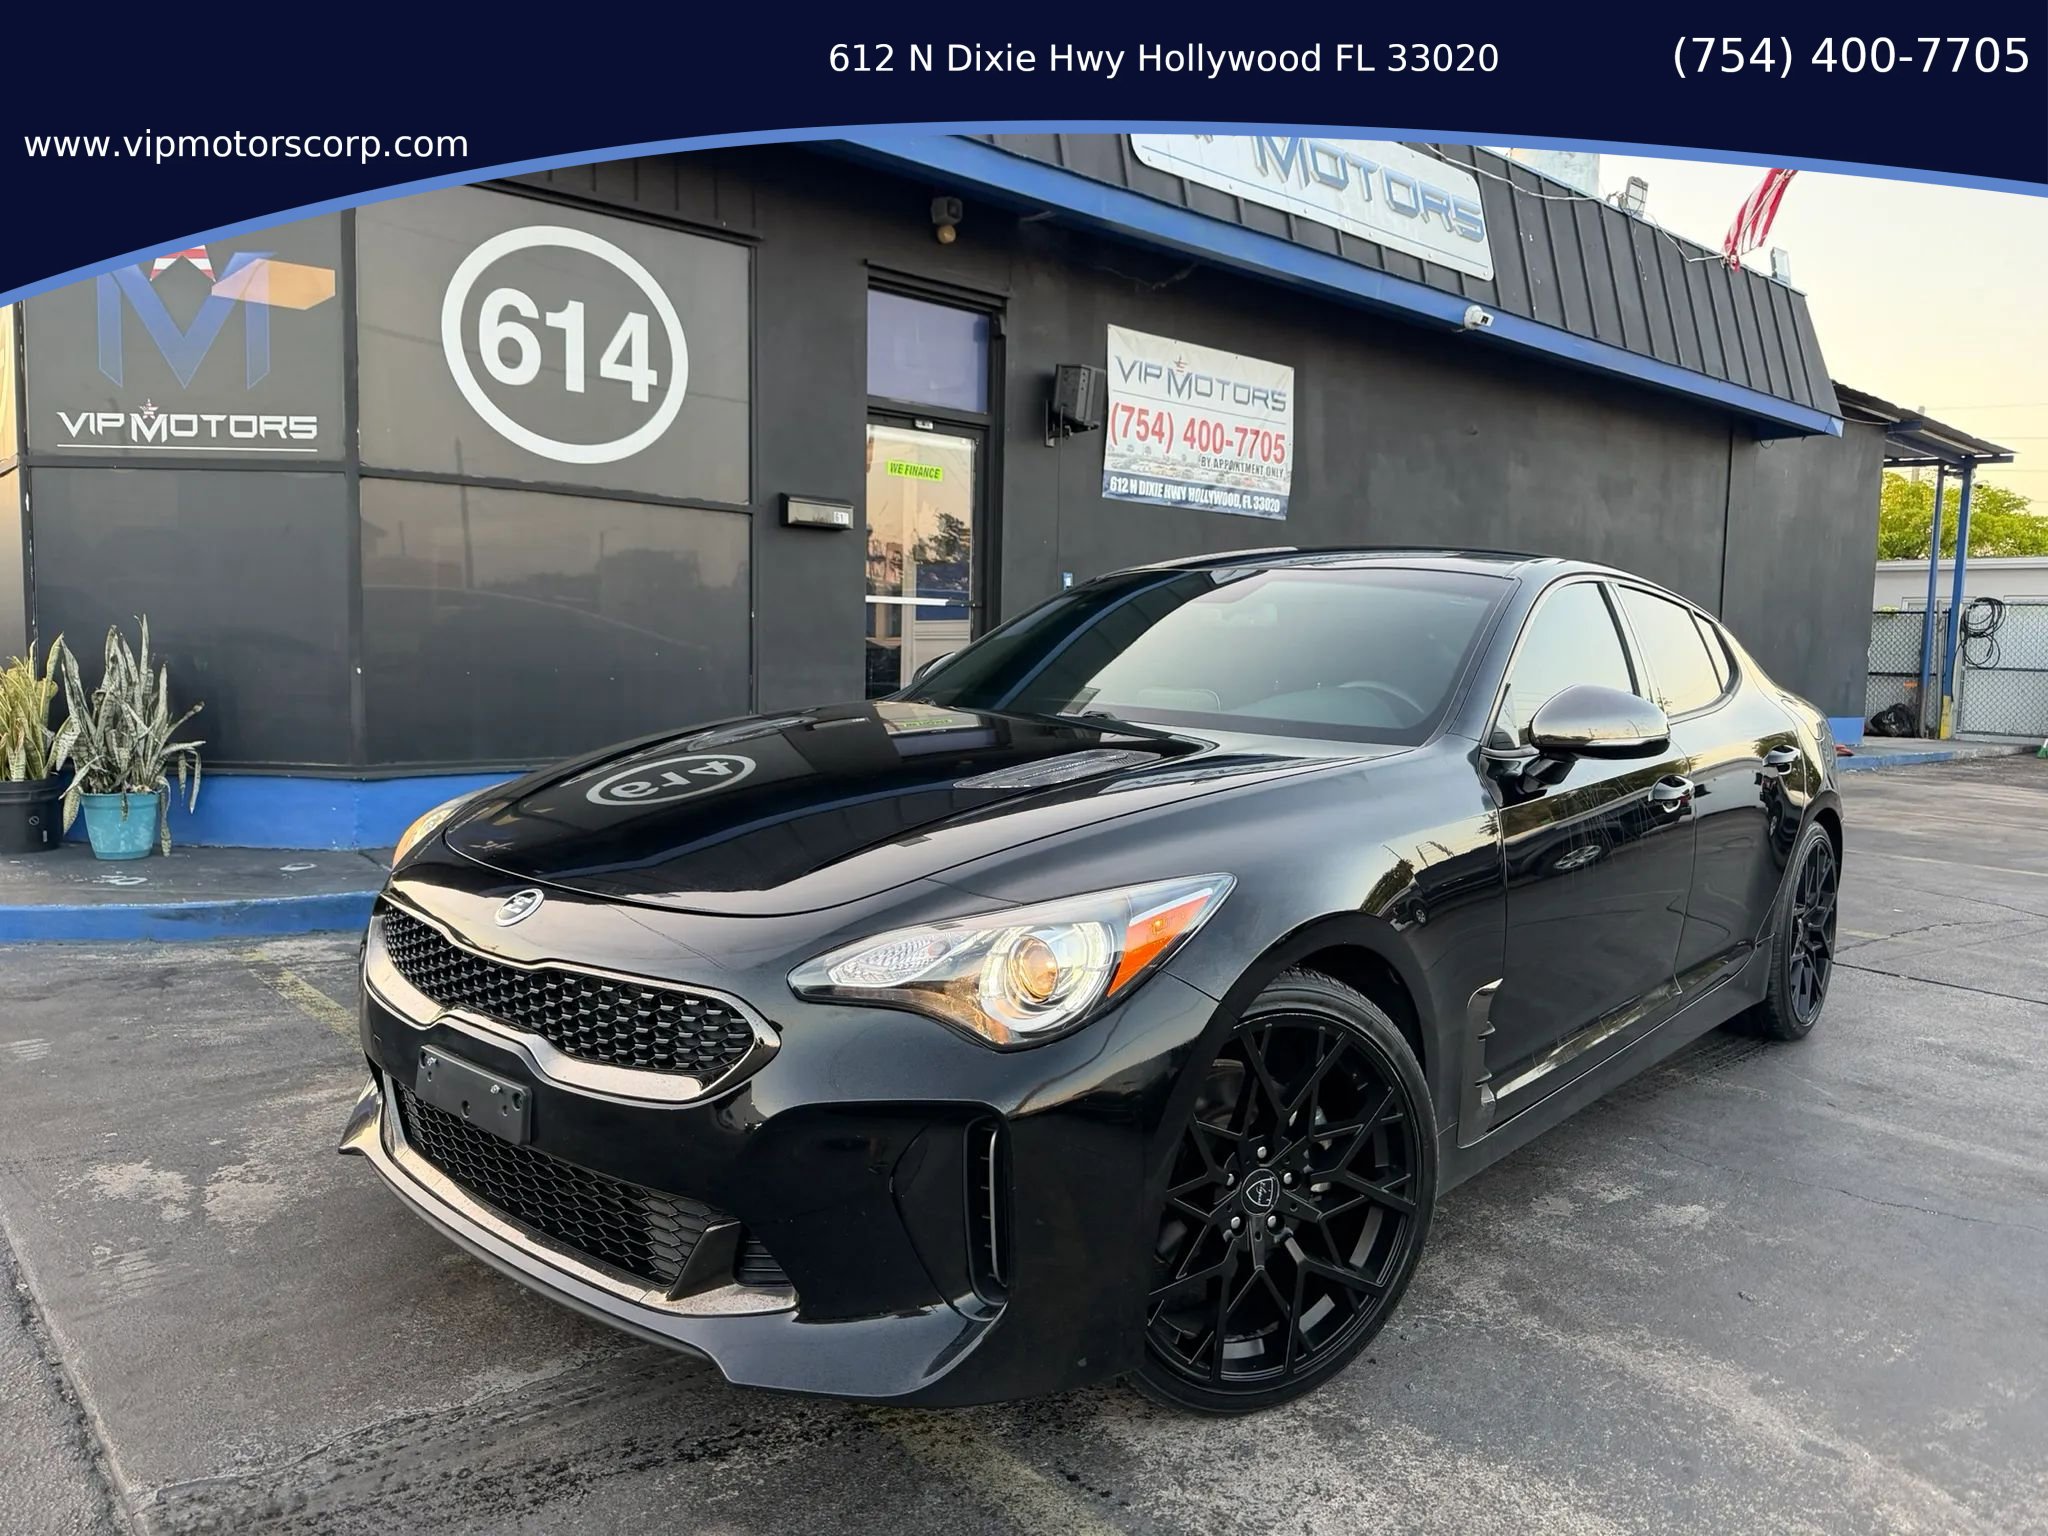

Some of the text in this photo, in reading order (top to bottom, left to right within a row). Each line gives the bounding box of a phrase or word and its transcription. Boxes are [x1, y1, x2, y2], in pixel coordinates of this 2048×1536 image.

[478, 286, 658, 403] 614
[1115, 355, 1287, 413] VIP MOTORS
[56, 411, 318, 443] VIP MOTORS
[1110, 402, 1286, 465] (754) 400-7705
[890, 462, 941, 479] WE FINANCE
[1201, 456, 1284, 479] BY APPOINTMENT ONLY
[1109, 476, 1129, 493] 612
[1129, 478, 1138, 495] N
[1138, 480, 1164, 498] DIXIE
[1163, 483, 1187, 501] HWY
[1242, 494, 1253, 509] FL
[1253, 495, 1281, 513] 33020
